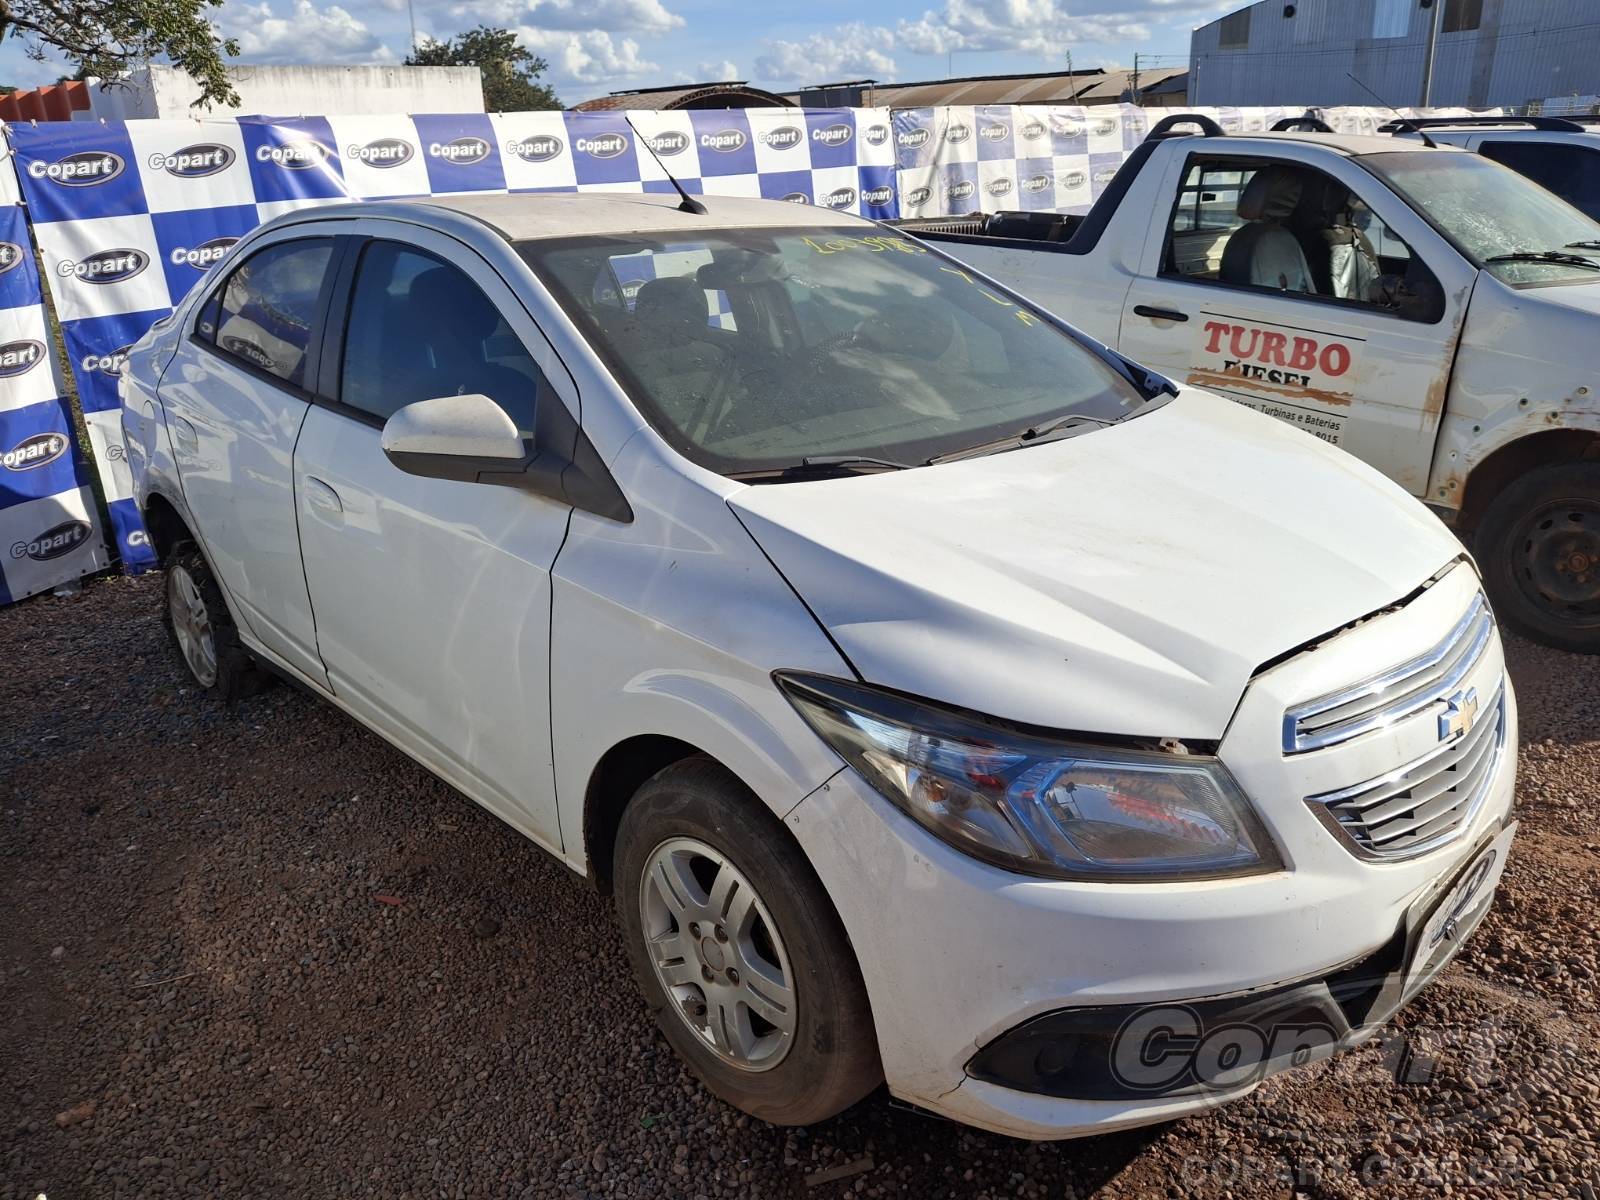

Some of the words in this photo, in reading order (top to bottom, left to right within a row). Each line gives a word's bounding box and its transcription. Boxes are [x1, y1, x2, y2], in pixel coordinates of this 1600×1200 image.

[758, 132, 797, 147] Copart
[812, 129, 849, 144] Copart
[861, 129, 884, 143] Copart
[898, 131, 927, 145] Copart
[980, 127, 1005, 138] Copart
[430, 141, 484, 159] Copart
[506, 140, 555, 156] Copart
[576, 137, 622, 154] Copart
[701, 134, 741, 149] Copart
[256, 144, 321, 164] Copa
[347, 140, 405, 162] Copart
[28, 156, 113, 181] Copart
[149, 150, 224, 175] Copart
[861, 187, 890, 202] Copart
[984, 180, 1010, 193] Copart
[819, 191, 852, 206] Copart
[57, 253, 136, 282] Copart
[1204, 321, 1351, 376] TURBO
[1261, 404, 1295, 420] Turbinas
[1298, 413, 1304, 422] e
[1305, 414, 1340, 430] Baterias
[0, 436, 60, 466] opart
[10, 524, 82, 559] Copart
